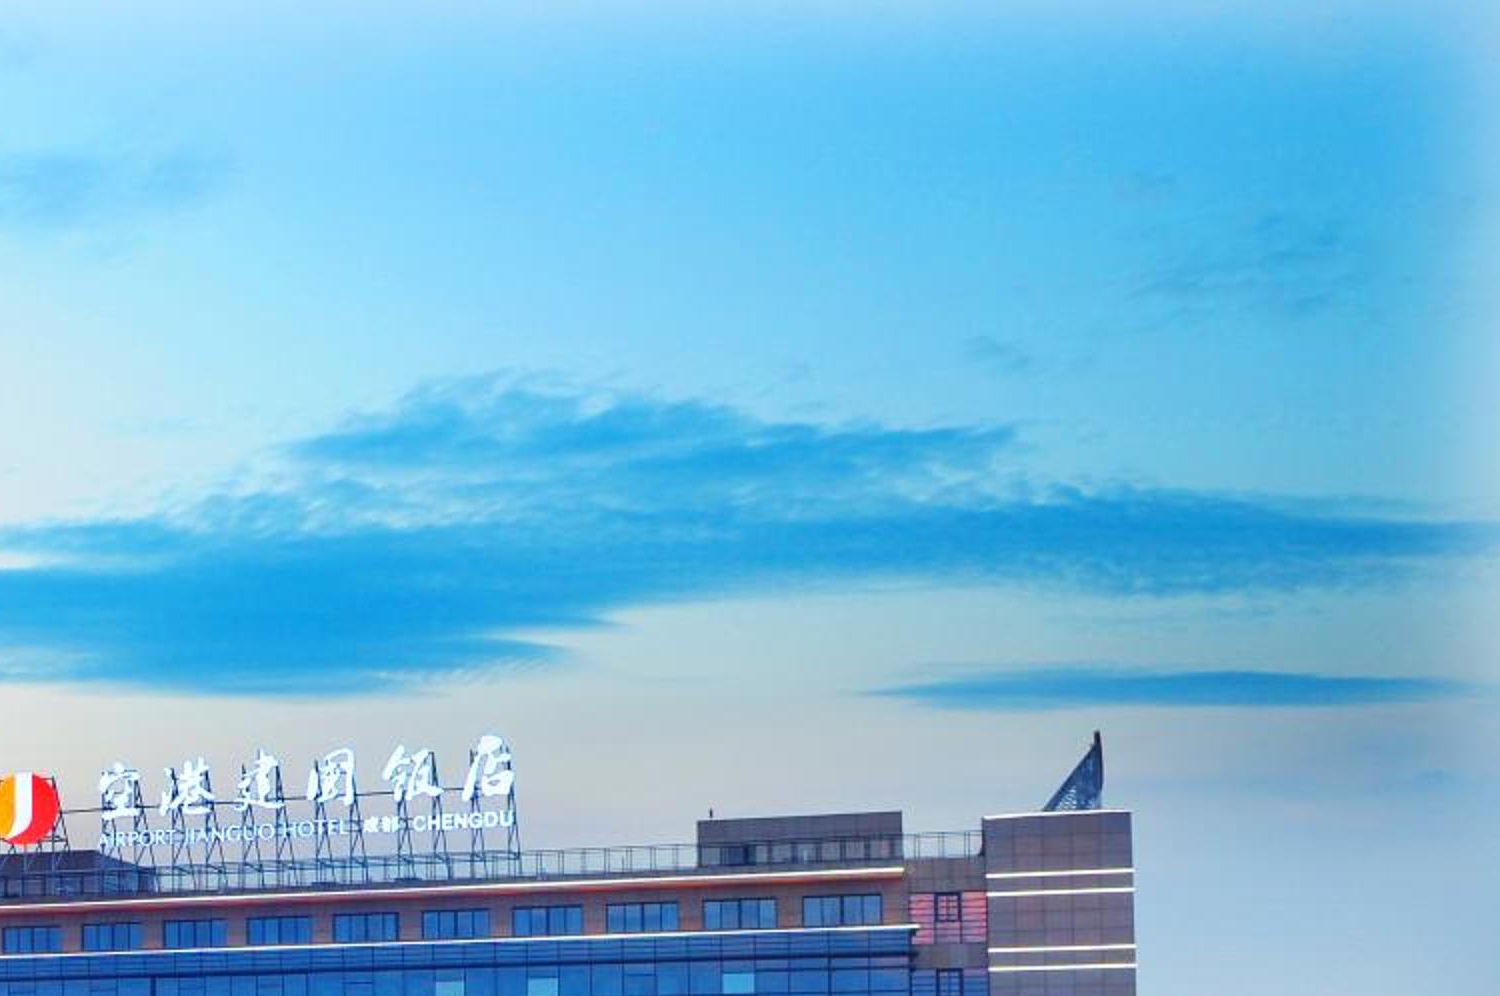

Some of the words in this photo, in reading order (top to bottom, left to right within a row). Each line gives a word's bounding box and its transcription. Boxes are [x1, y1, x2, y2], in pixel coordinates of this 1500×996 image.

[98, 829, 176, 848] AIRPORT
[182, 823, 277, 846] JIANGUO
[284, 819, 349, 838] HOTEL
[363, 815, 401, 833] 成都
[412, 809, 515, 832] CHENGDU
